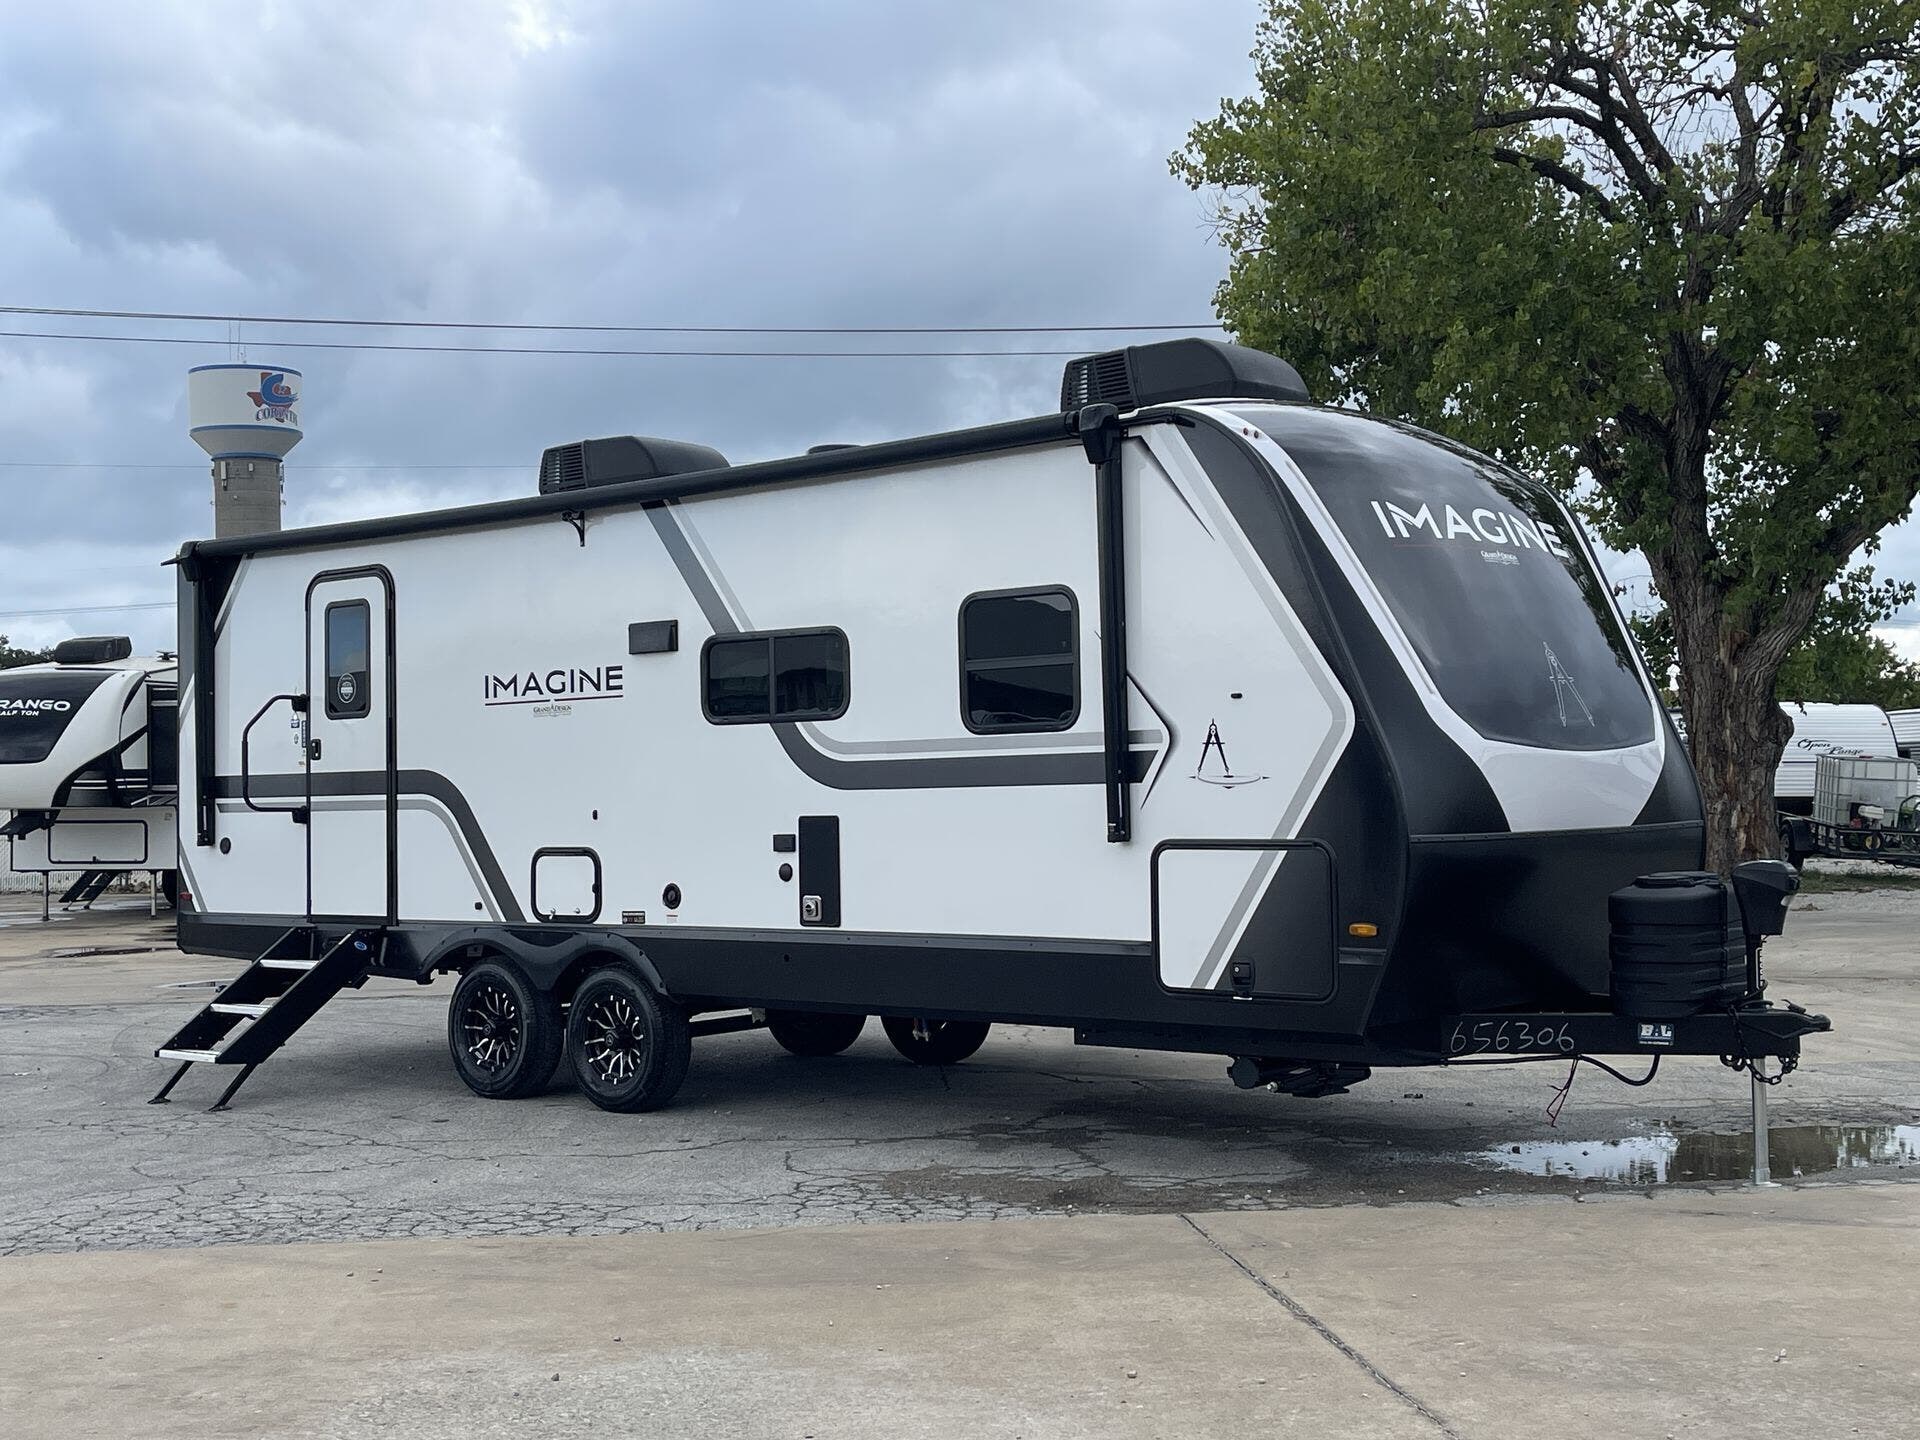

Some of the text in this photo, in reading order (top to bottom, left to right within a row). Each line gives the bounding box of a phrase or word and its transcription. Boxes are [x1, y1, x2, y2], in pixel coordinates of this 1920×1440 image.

[1371, 500, 1569, 559] IMAGINE
[485, 665, 623, 699] IMAGINE
[1797, 739, 1831, 751] Open
[1451, 1021, 1575, 1053] 656306
